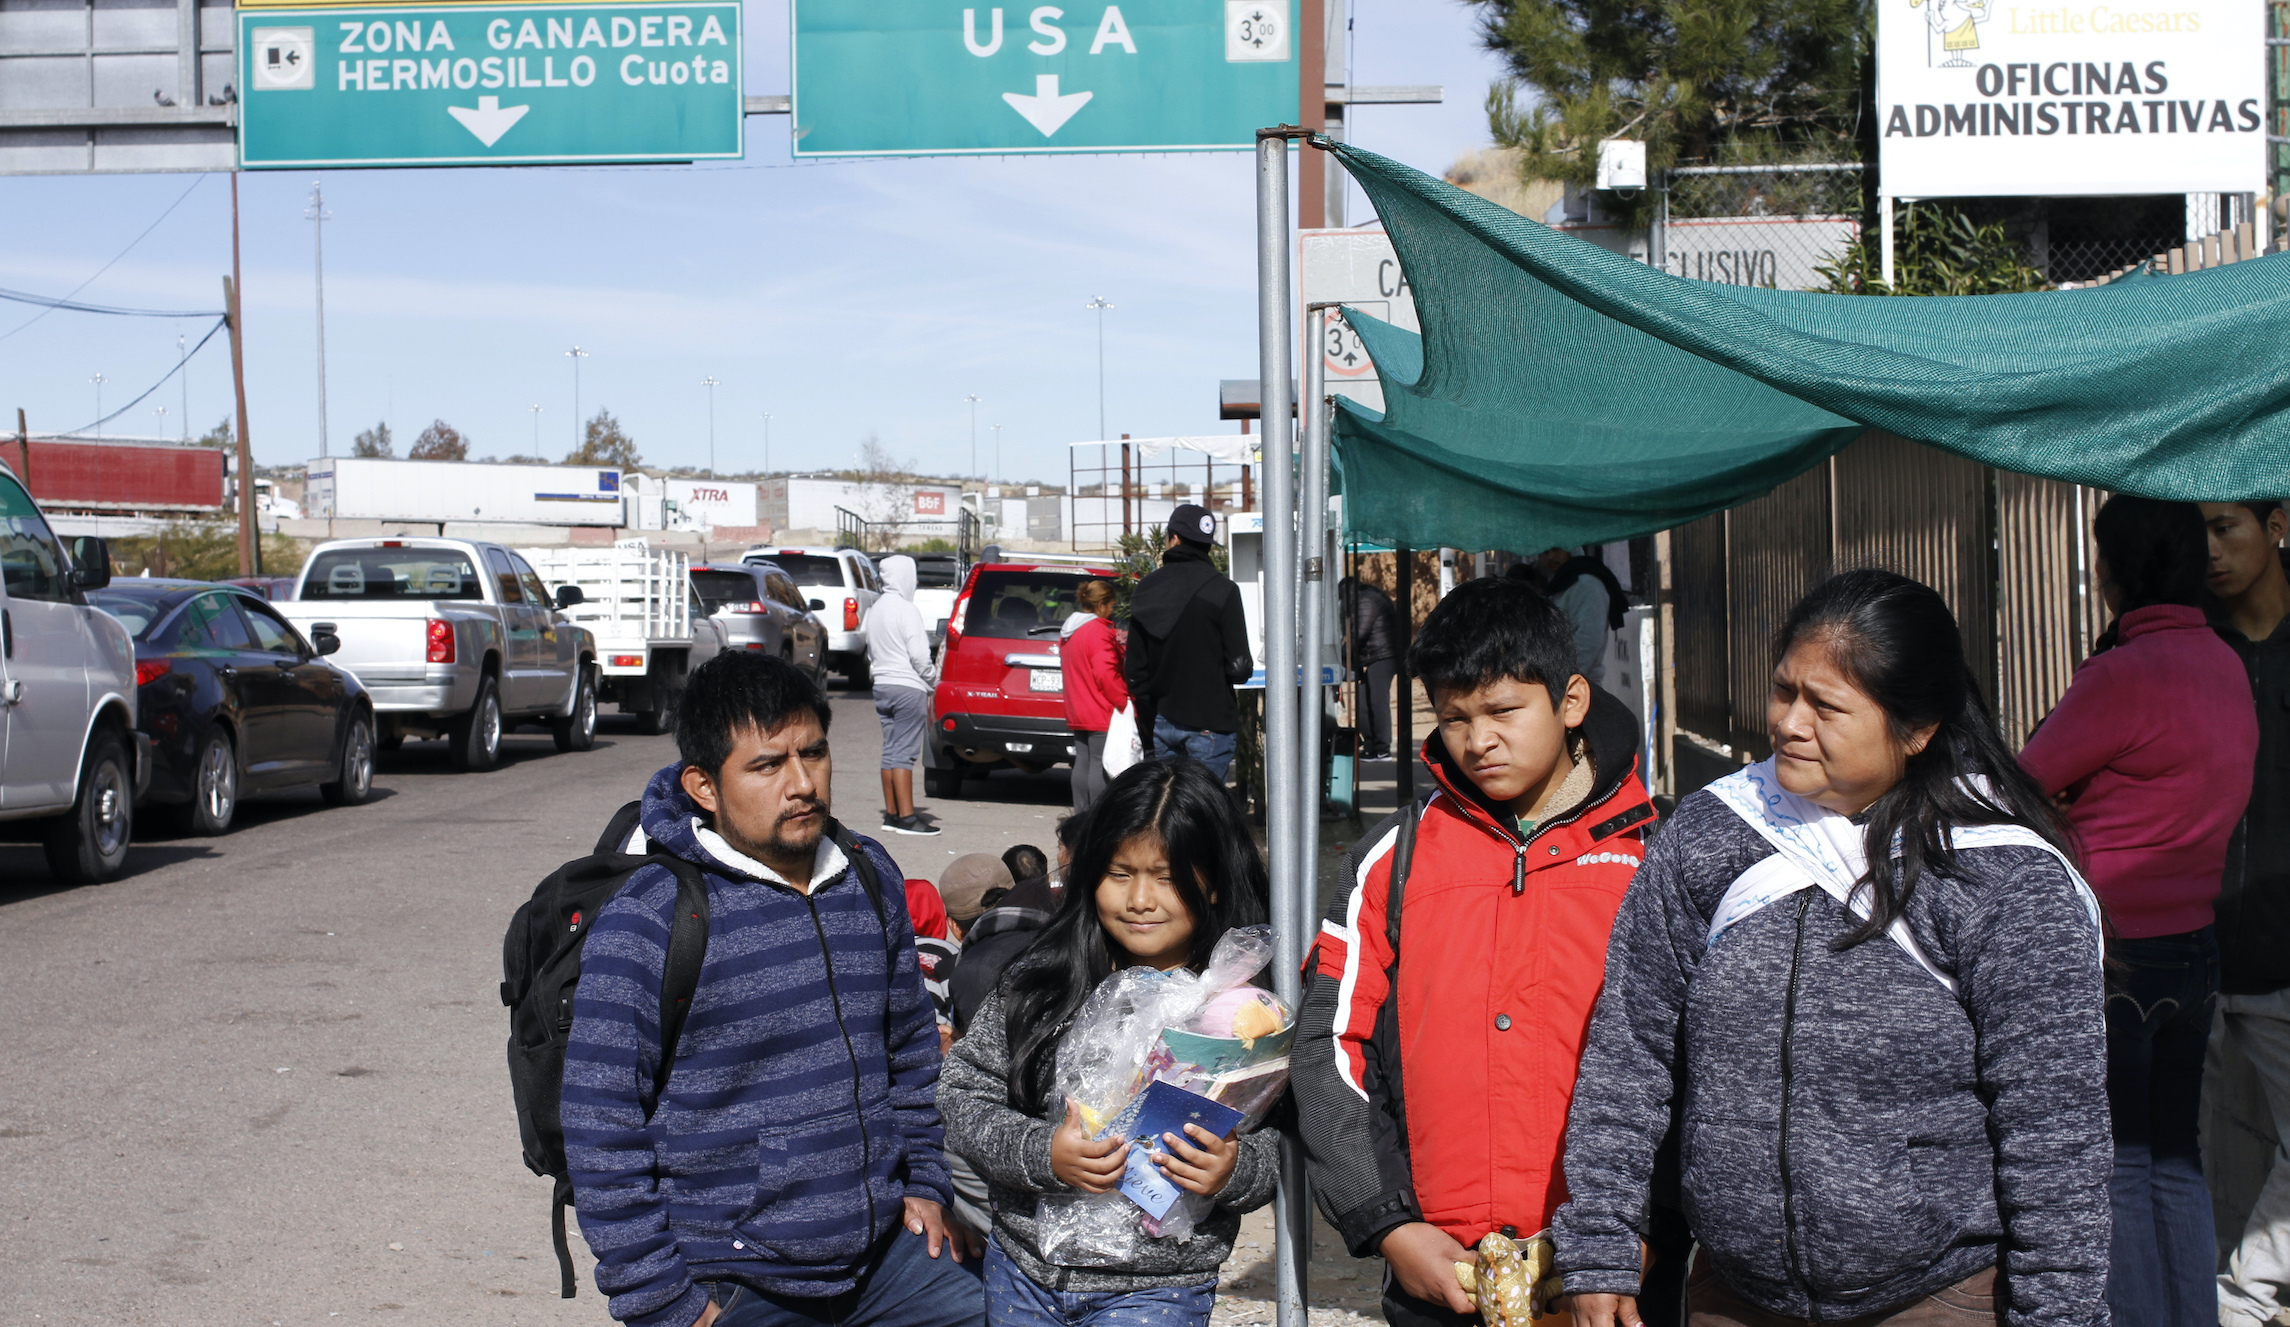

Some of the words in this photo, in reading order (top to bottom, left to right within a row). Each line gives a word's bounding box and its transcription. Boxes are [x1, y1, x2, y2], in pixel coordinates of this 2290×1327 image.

[338, 20, 455, 54] ZONA
[486, 15, 728, 50] GANADERA
[2008, 7, 2084, 35] Little
[2089, 5, 2201, 34] Caesars
[338, 56, 597, 92] HERMOSILLO
[620, 53, 729, 86] Cuota
[1975, 61, 2168, 97] OFICINAS
[1885, 99, 2261, 138] ADMINISTRATIVAS
[688, 487, 729, 504] XTRA
[918, 496, 940, 509] B&F
